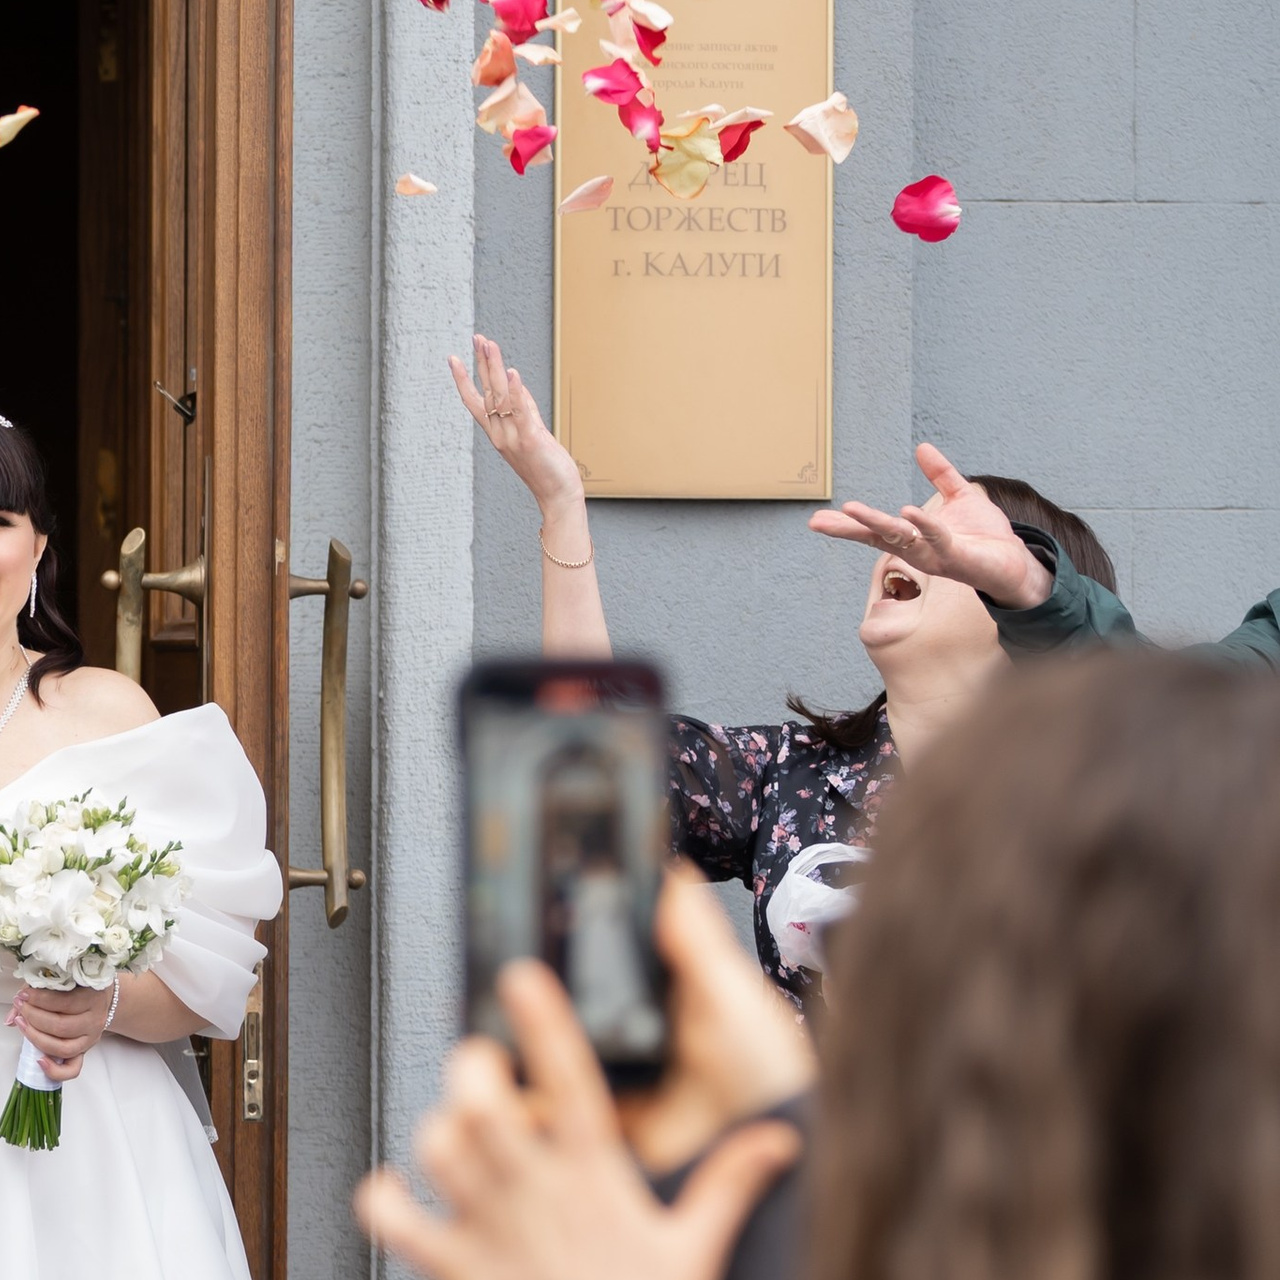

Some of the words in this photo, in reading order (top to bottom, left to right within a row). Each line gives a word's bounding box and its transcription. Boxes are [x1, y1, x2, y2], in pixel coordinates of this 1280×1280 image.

[697, 42, 741, 52] записи
[744, 42, 778, 53] актов
[711, 61, 775, 71] состояния
[652, 79, 695, 92] города
[699, 77, 744, 92] Калуги
[605, 206, 787, 233] ТОРЖЕСТВ
[612, 259, 631, 277] г.
[643, 252, 781, 278] КАЛУГИ
